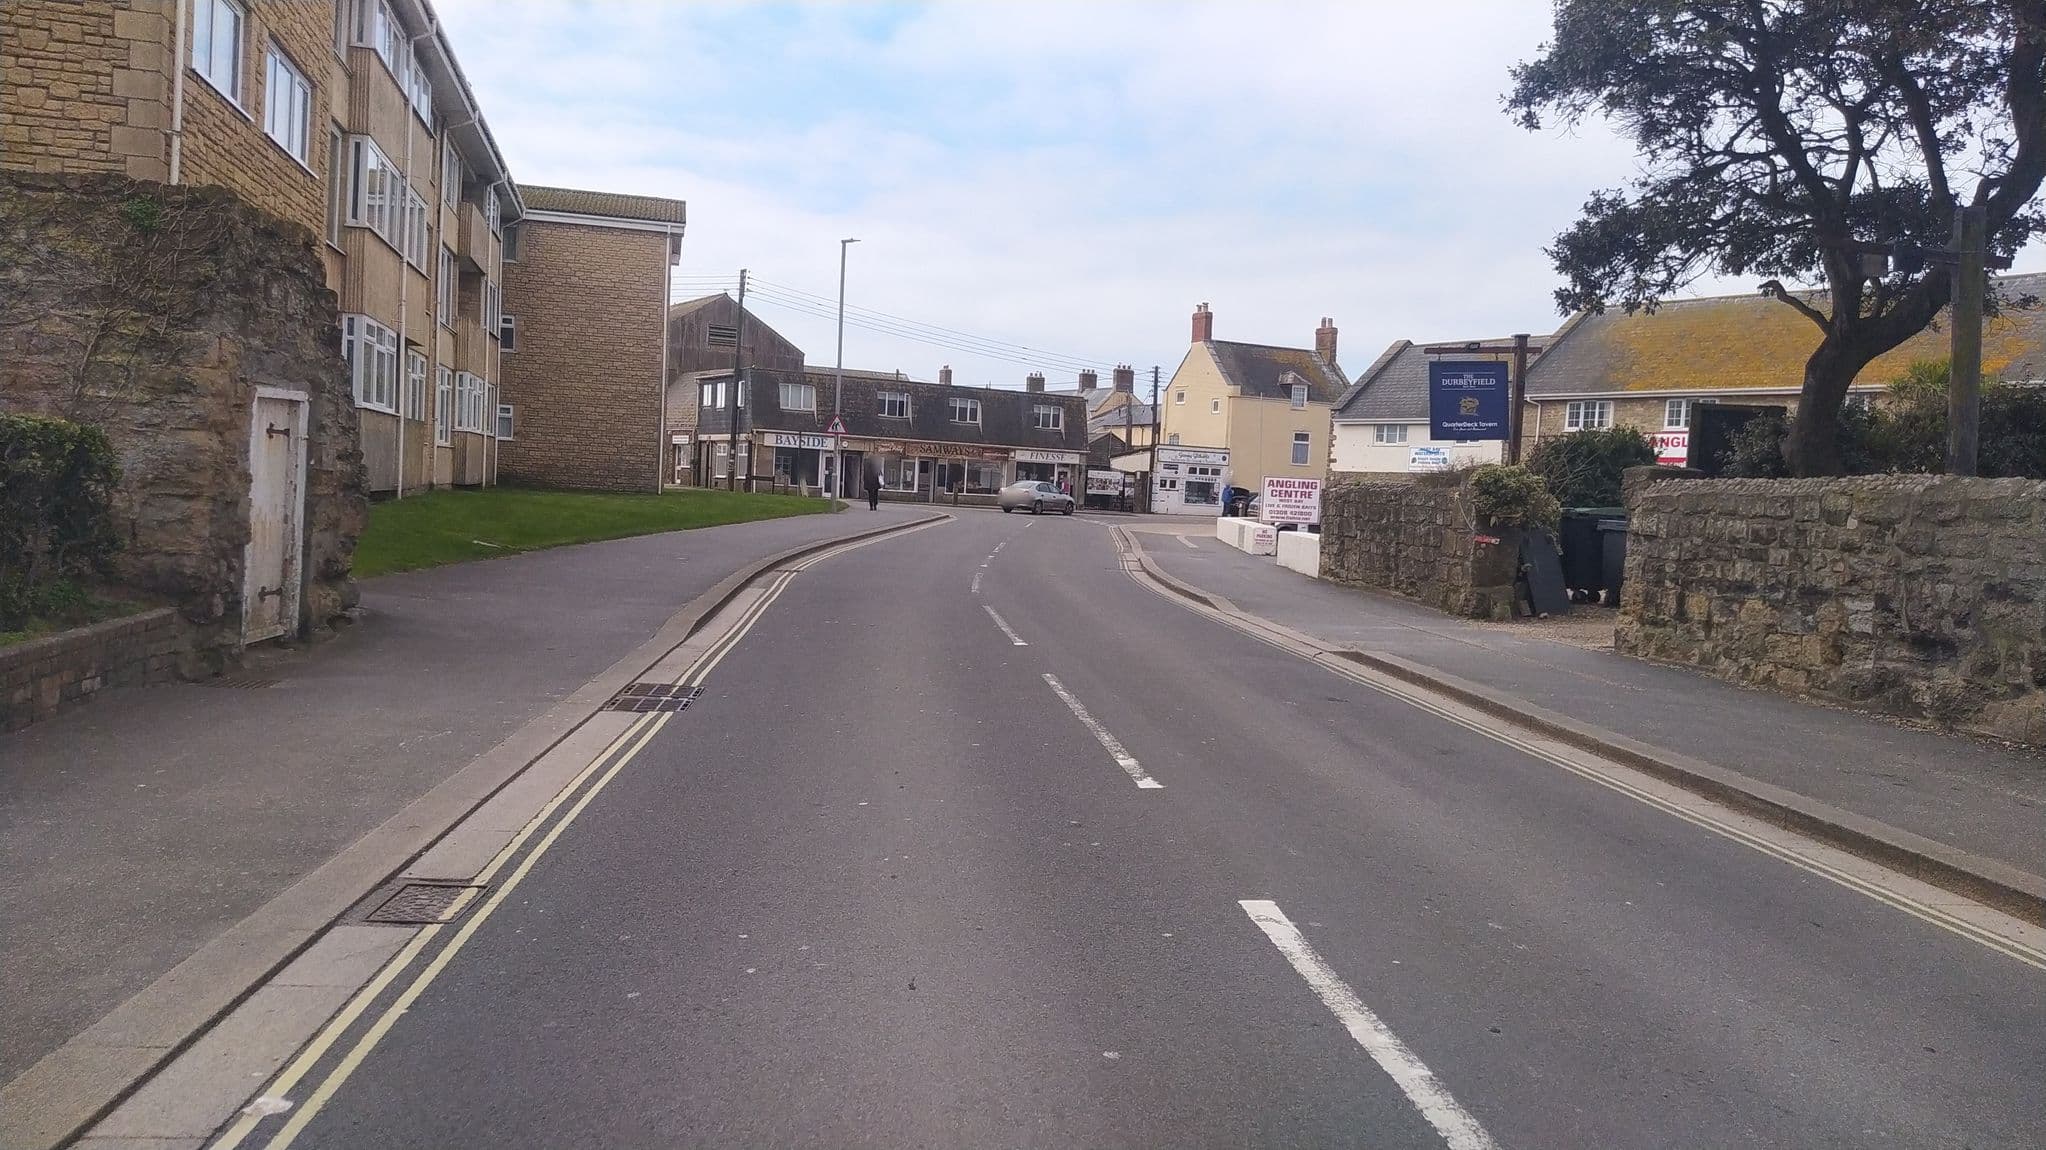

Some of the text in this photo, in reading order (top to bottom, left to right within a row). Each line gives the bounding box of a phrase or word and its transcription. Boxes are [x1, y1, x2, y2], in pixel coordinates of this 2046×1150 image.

[1441, 378, 1496, 386] DURBEYFIELD
[775, 434, 828, 448] BAYSIDE
[920, 443, 969, 456] SAMWAYS
[1030, 452, 1065, 461] FINESSE
[1267, 479, 1318, 490] ANGLING
[1270, 489, 1313, 499] CENTRE
